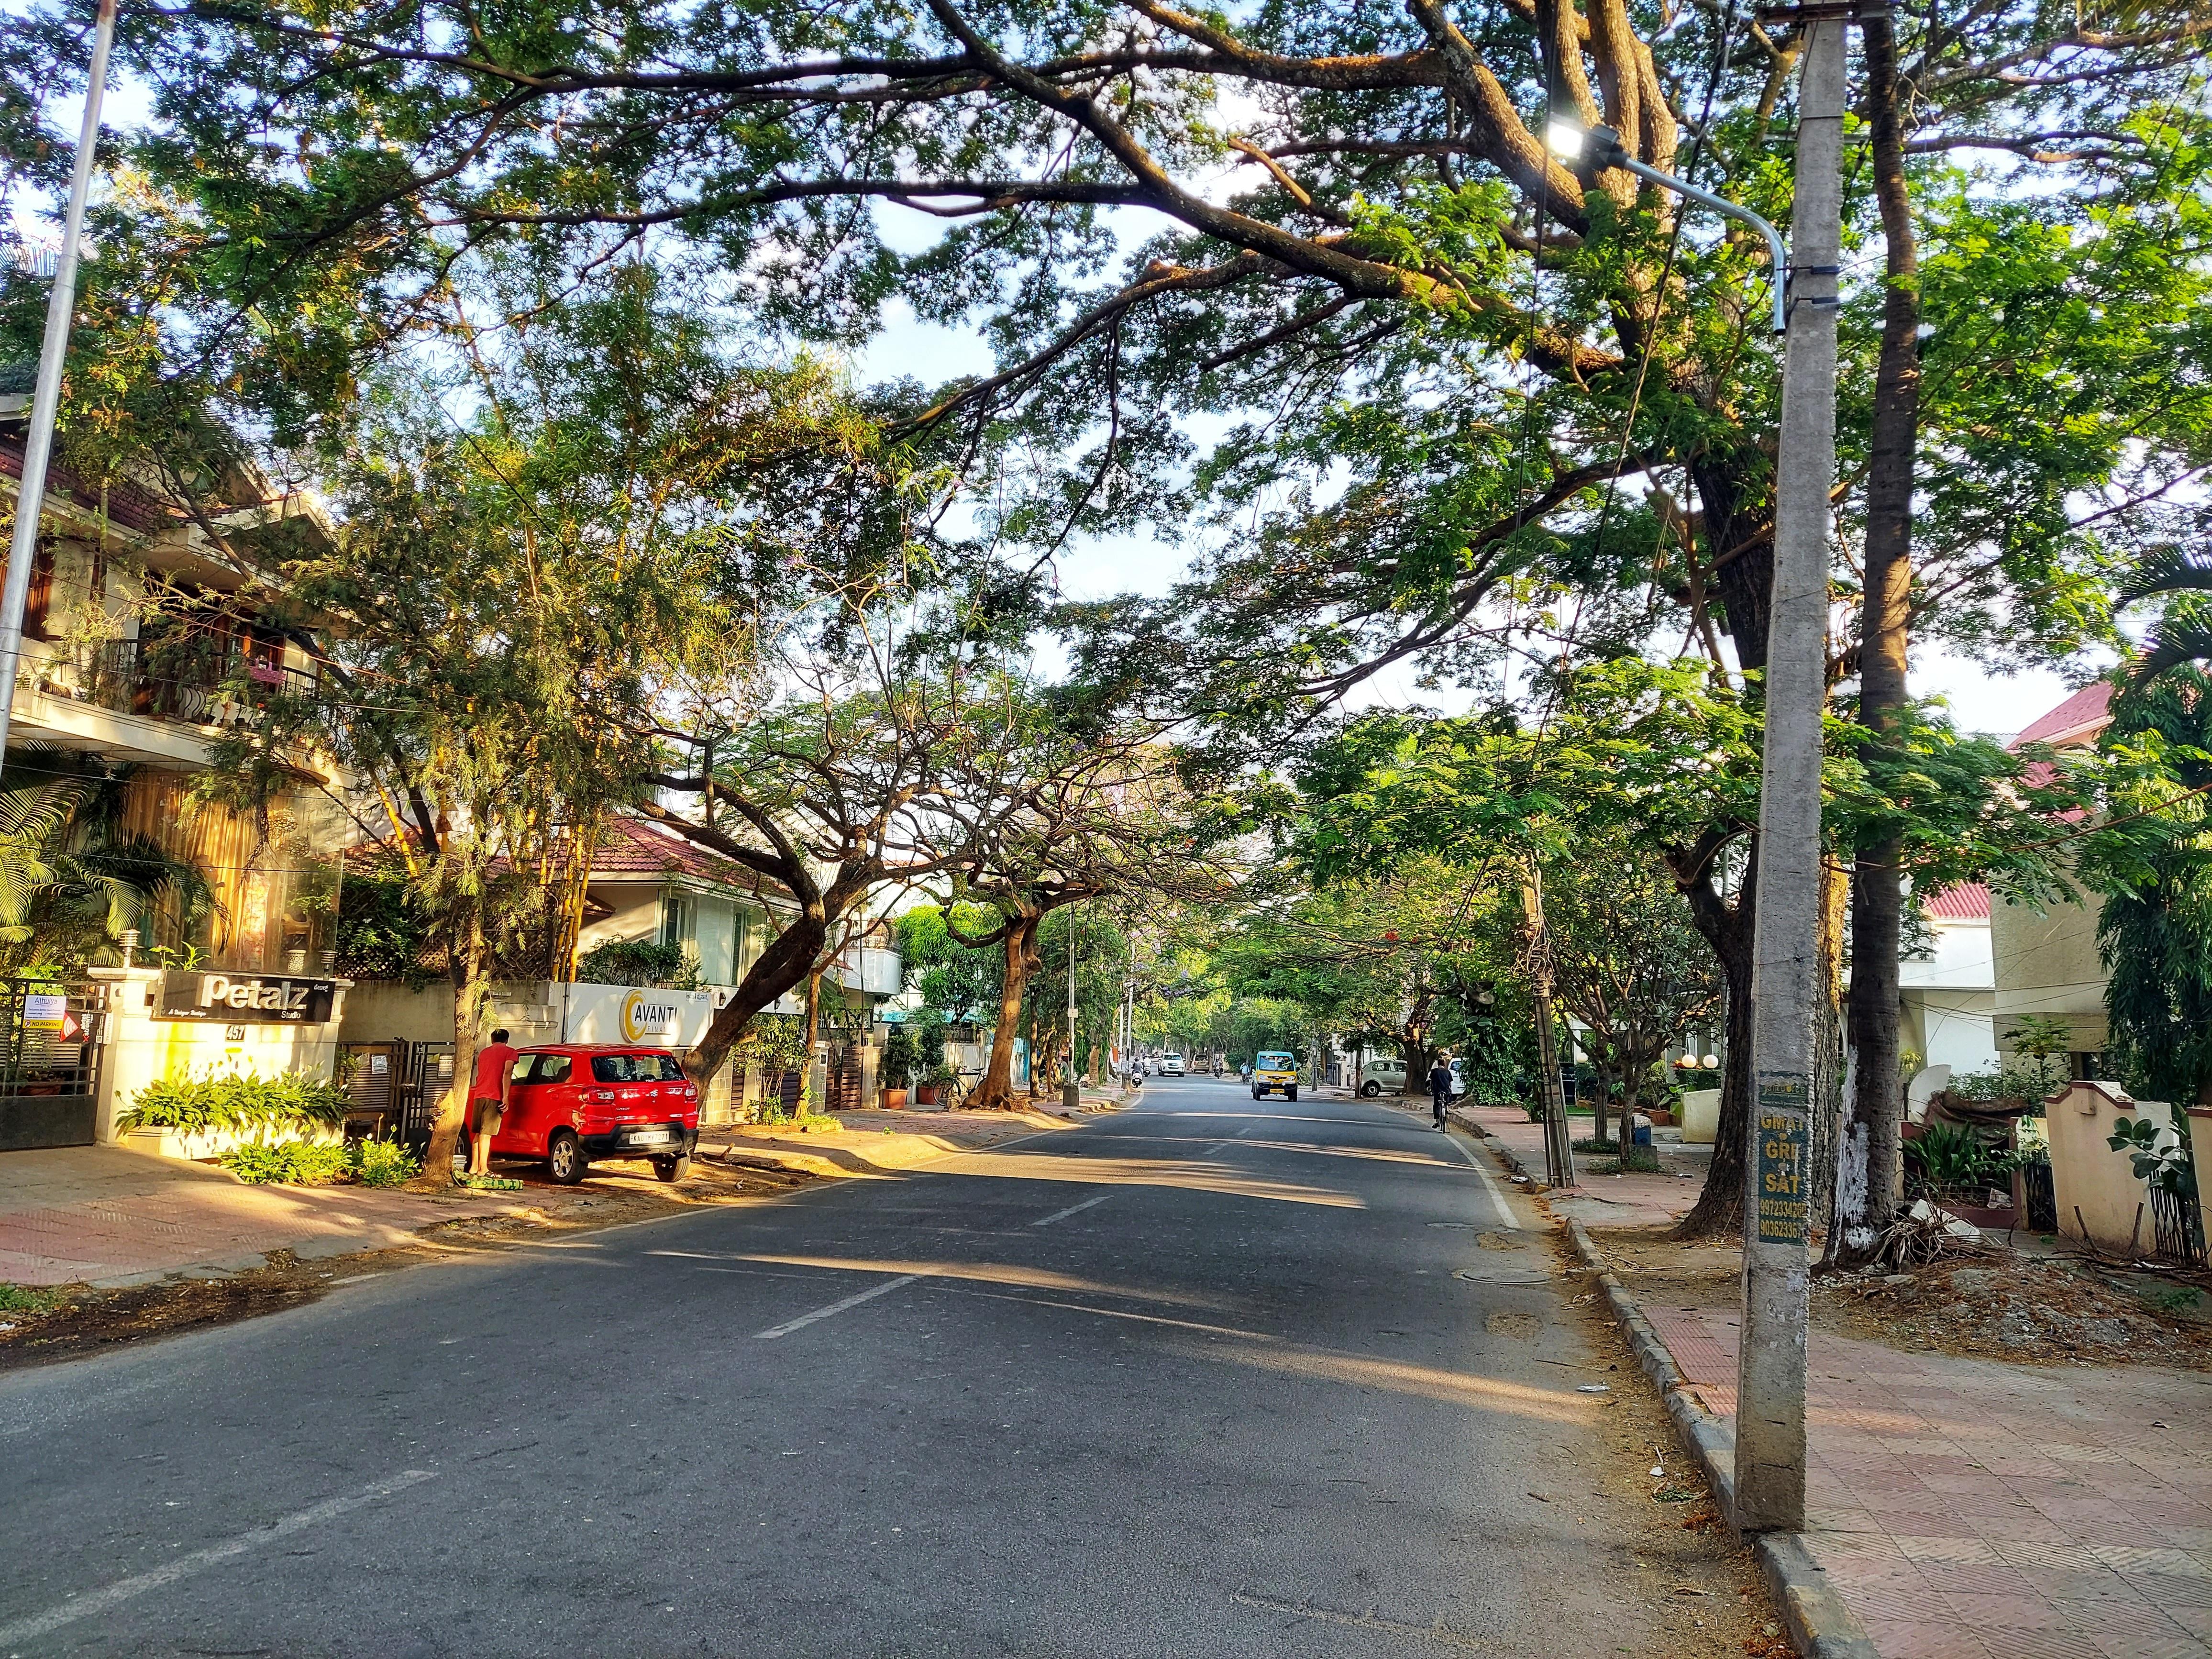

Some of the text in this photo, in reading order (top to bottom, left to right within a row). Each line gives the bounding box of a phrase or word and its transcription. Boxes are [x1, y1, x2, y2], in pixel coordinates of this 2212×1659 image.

[200, 975, 310, 1010] Petalz
[281, 1011, 301, 1019] Studio
[634, 1005, 677, 1023] AVANTI
[227, 1026, 245, 1040] 457
[1766, 1173, 1802, 1194] SAT
